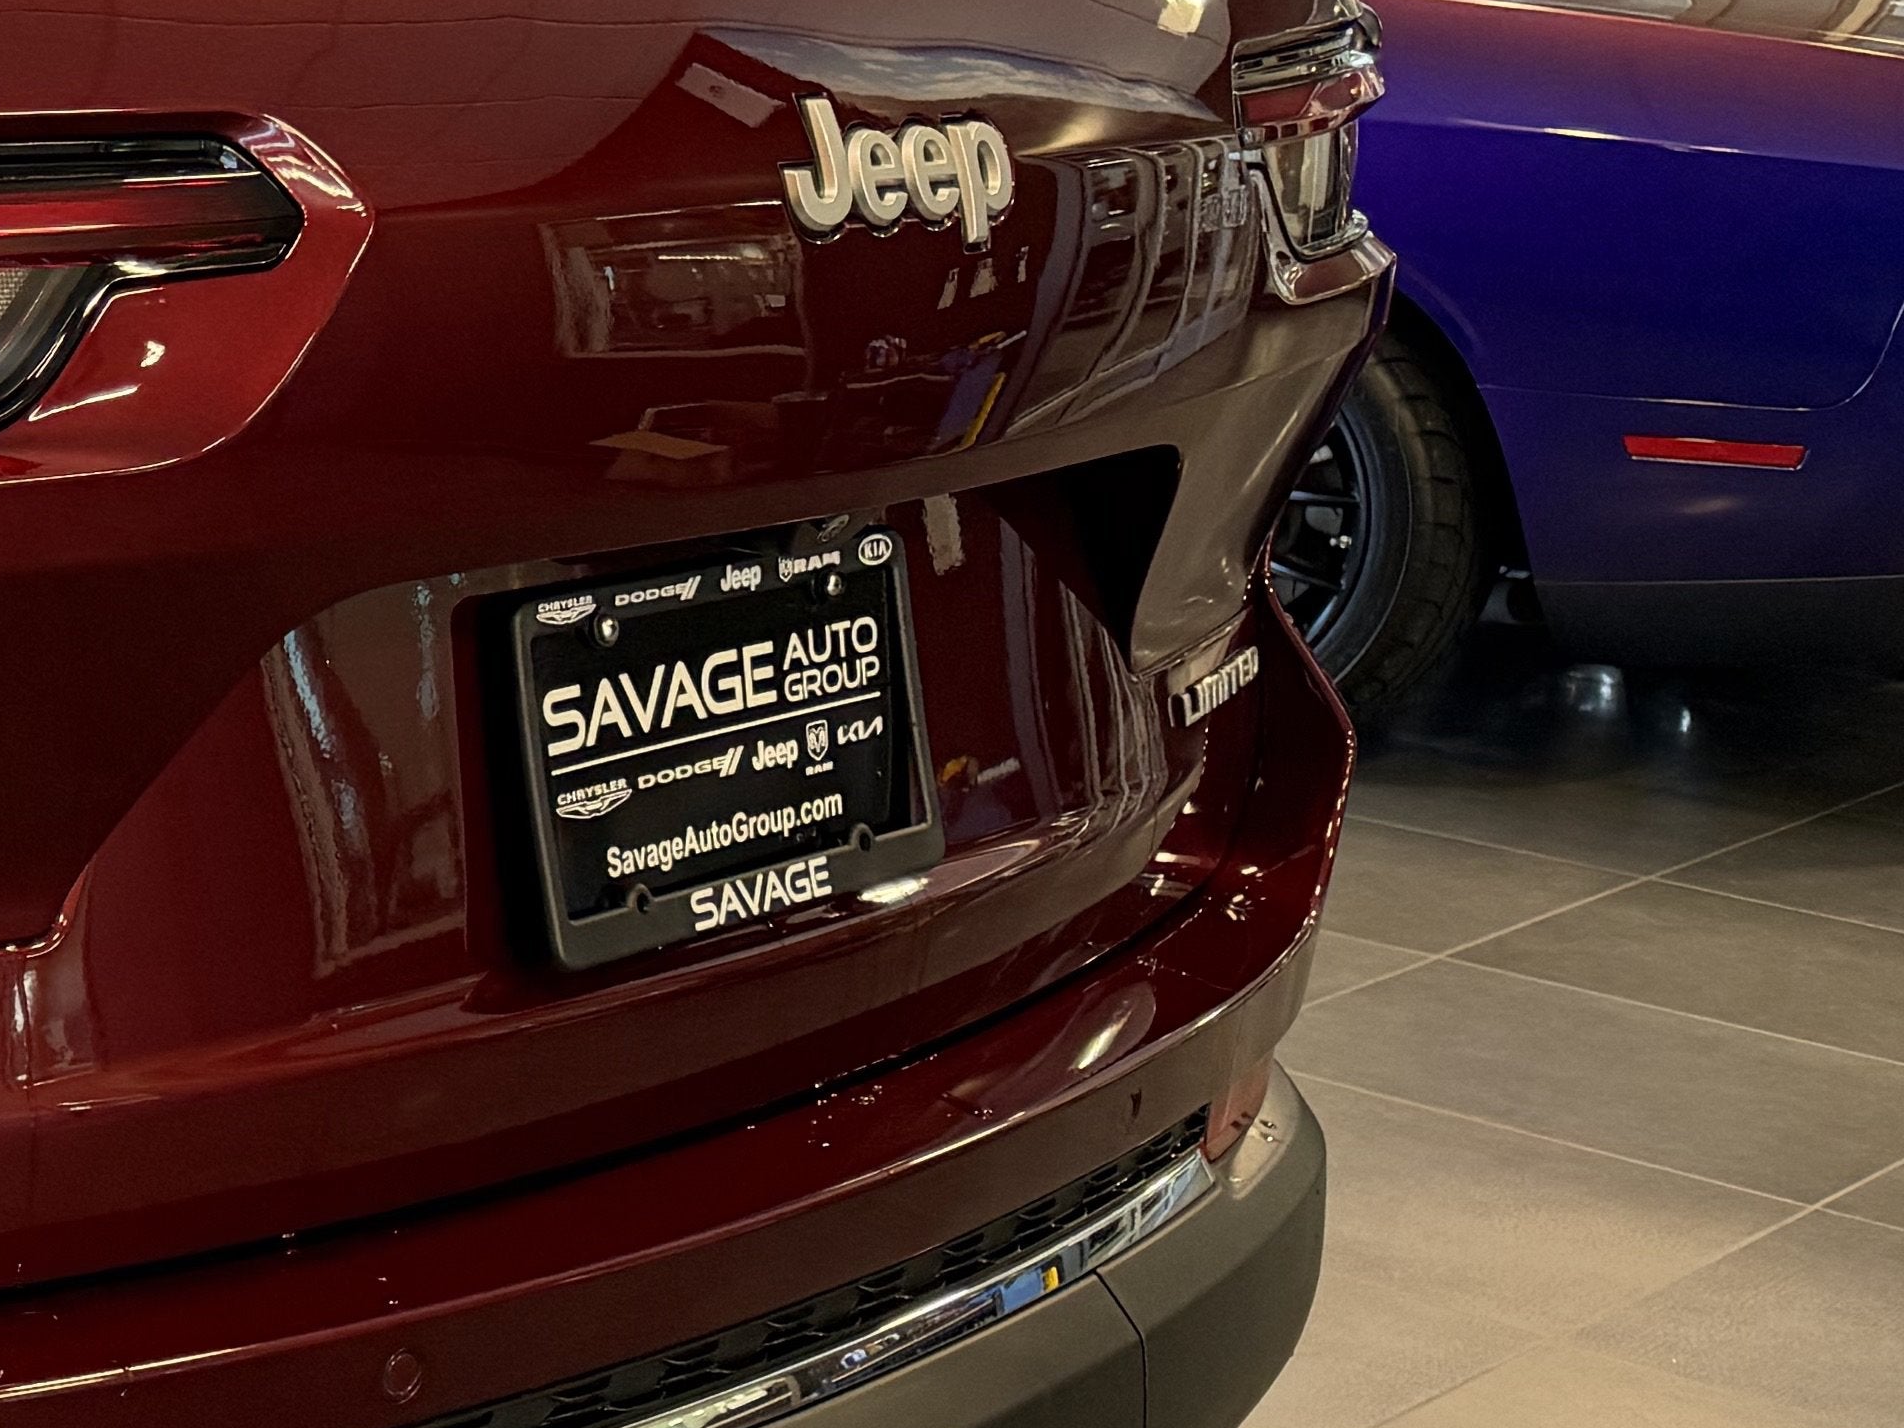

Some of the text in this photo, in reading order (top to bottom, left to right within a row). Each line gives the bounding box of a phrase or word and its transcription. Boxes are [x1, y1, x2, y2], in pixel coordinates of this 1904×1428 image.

[780, 92, 1015, 253] Jeep
[537, 539, 889, 613] CHRYSLER DODGE Jeep RAM KIA
[542, 615, 881, 756] SAVAGE AUTO GROUP
[556, 778, 628, 805] CHRYSLER
[637, 753, 731, 790] DODGE
[752, 739, 799, 771] Jeep
[805, 760, 834, 777] RAM
[607, 791, 844, 879] SavageAutoGroup.com
[690, 855, 834, 933] SAVAGE
